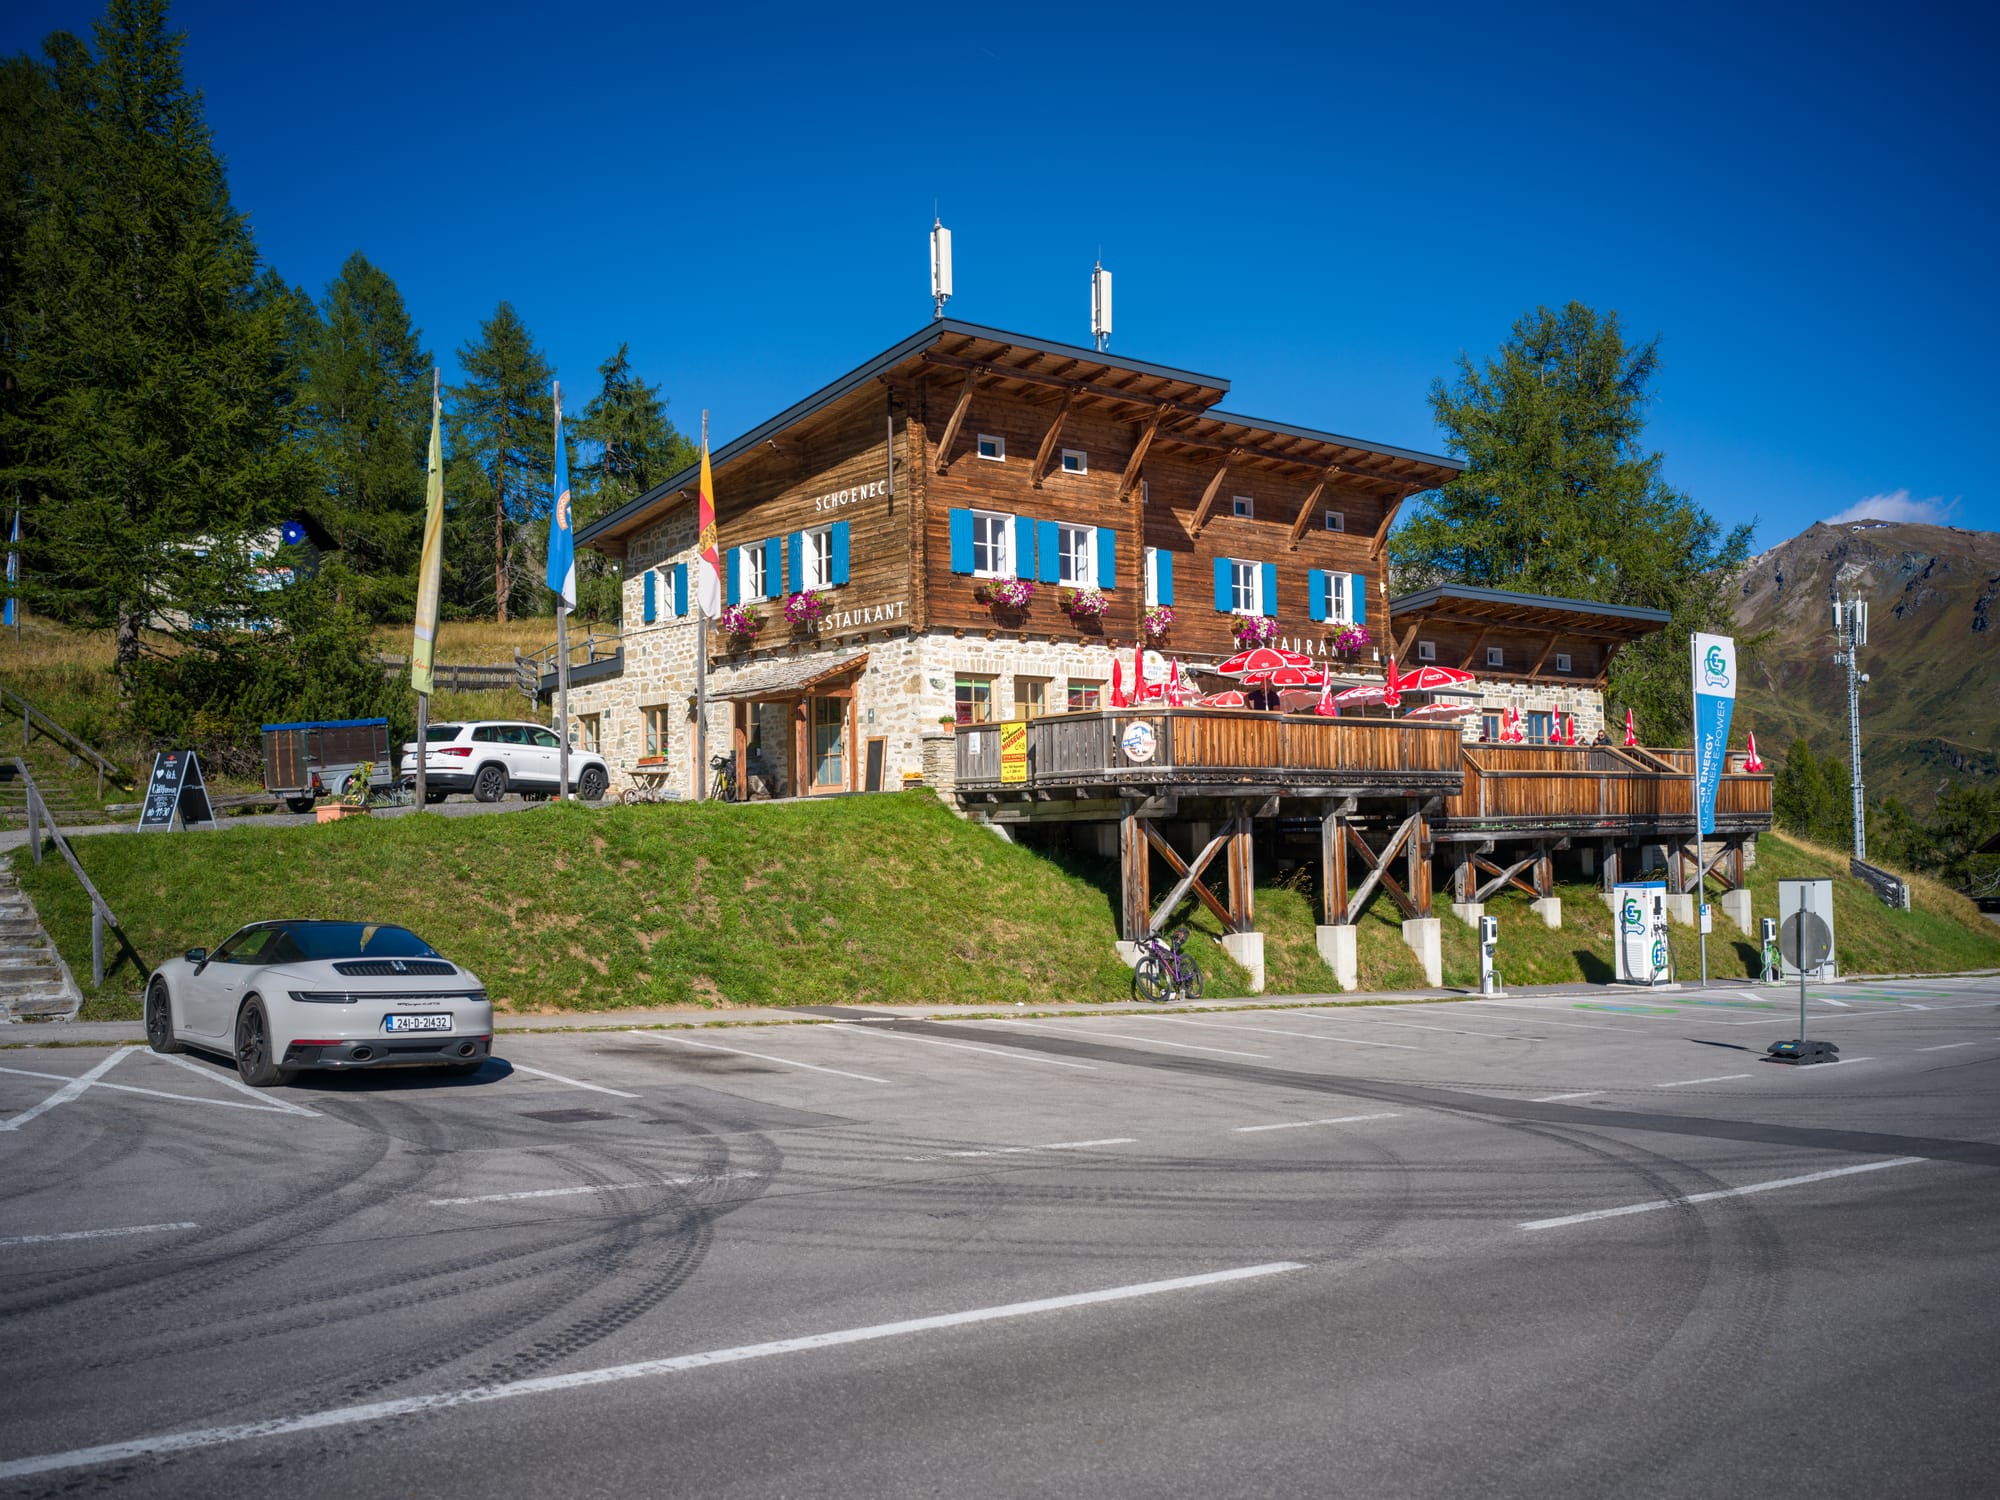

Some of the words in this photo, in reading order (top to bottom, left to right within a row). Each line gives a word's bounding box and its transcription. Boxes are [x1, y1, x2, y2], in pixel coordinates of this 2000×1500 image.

[815, 480, 886, 512] SCHOENEC
[807, 601, 904, 633] RESTAURANT
[1001, 729, 1026, 752] MUSEUM
[1712, 700, 1726, 760] E-POWER
[1700, 733, 1714, 784] ENERGY
